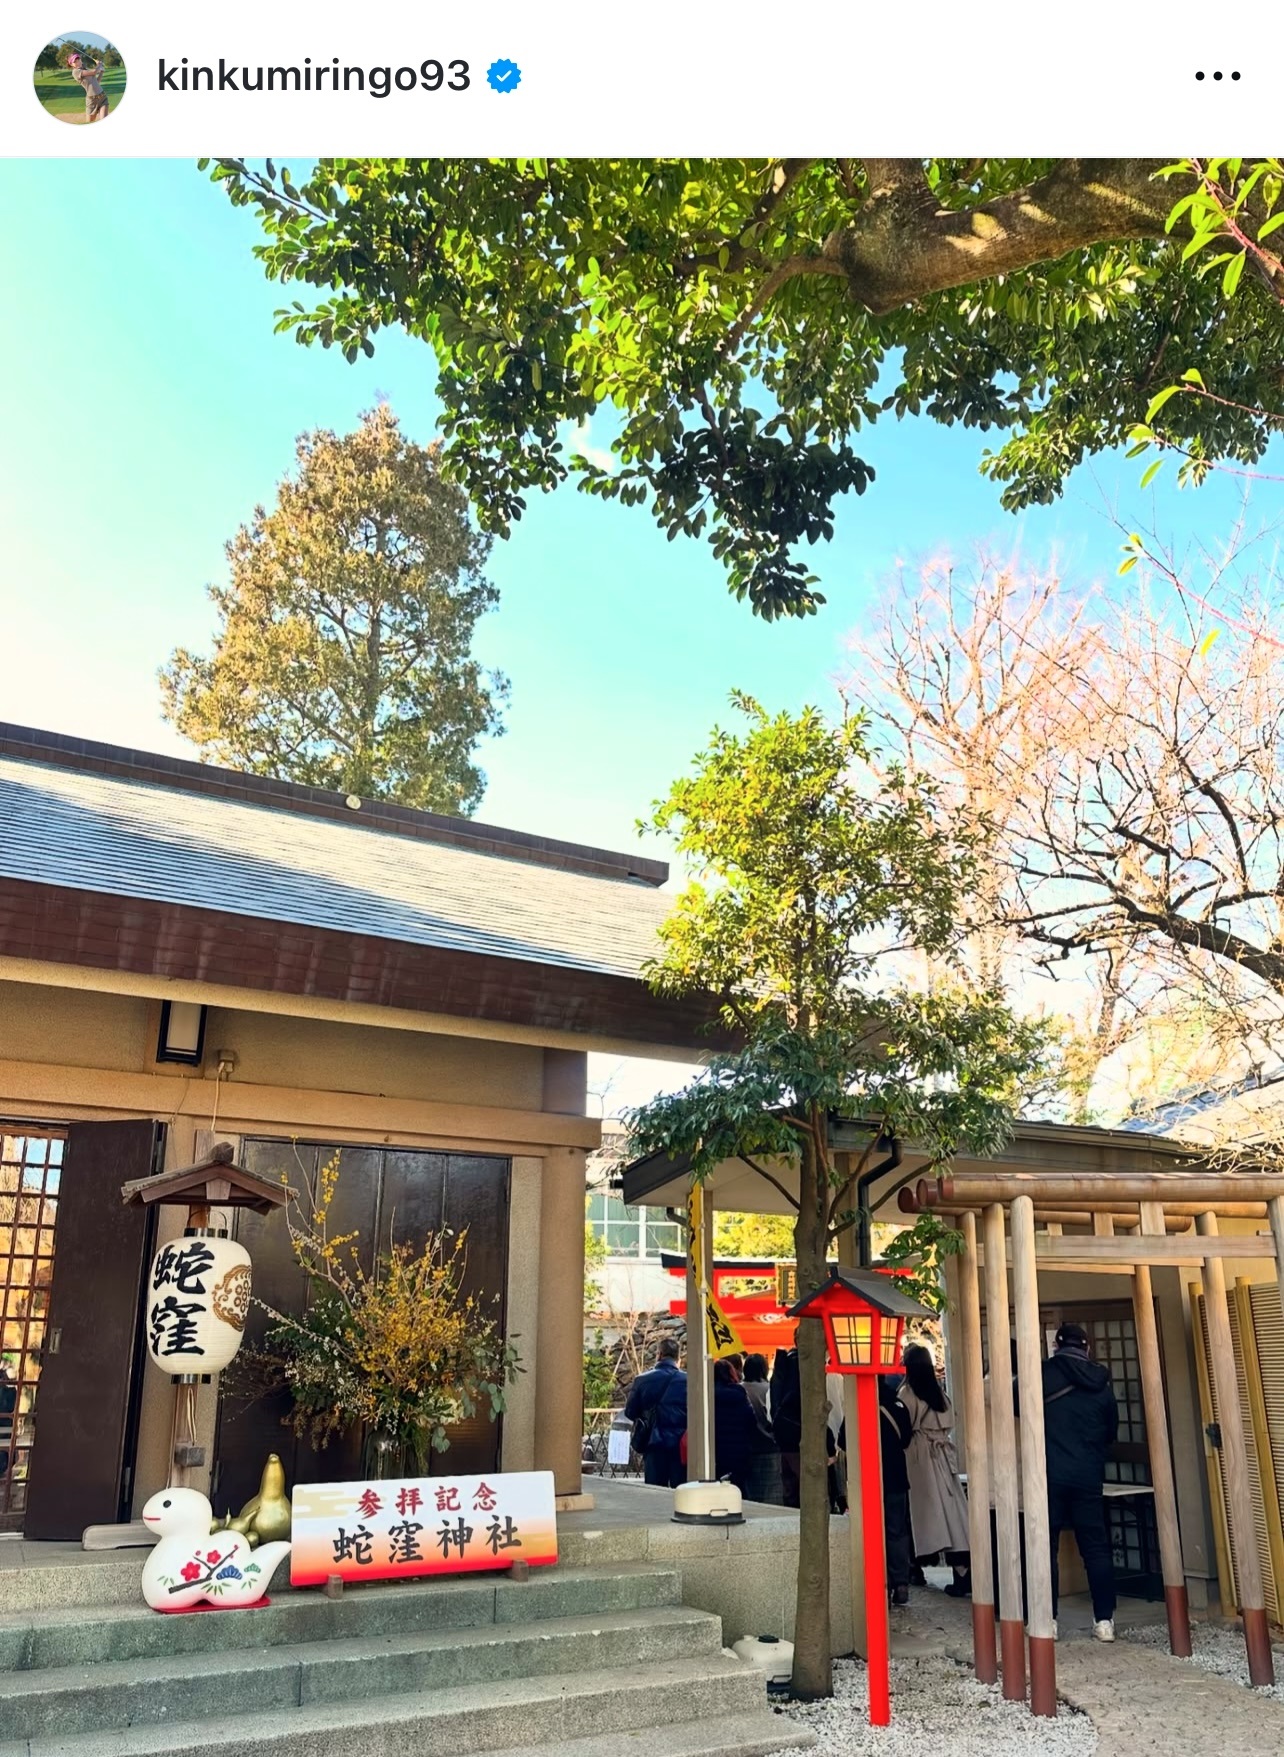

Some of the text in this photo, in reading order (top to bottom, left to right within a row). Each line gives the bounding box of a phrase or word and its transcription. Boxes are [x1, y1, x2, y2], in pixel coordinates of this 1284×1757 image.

[151, 1241, 215, 1357] 蛇窪
[355, 1481, 498, 1520] 参拝記念
[332, 1514, 522, 1566] 蛇窪神社
